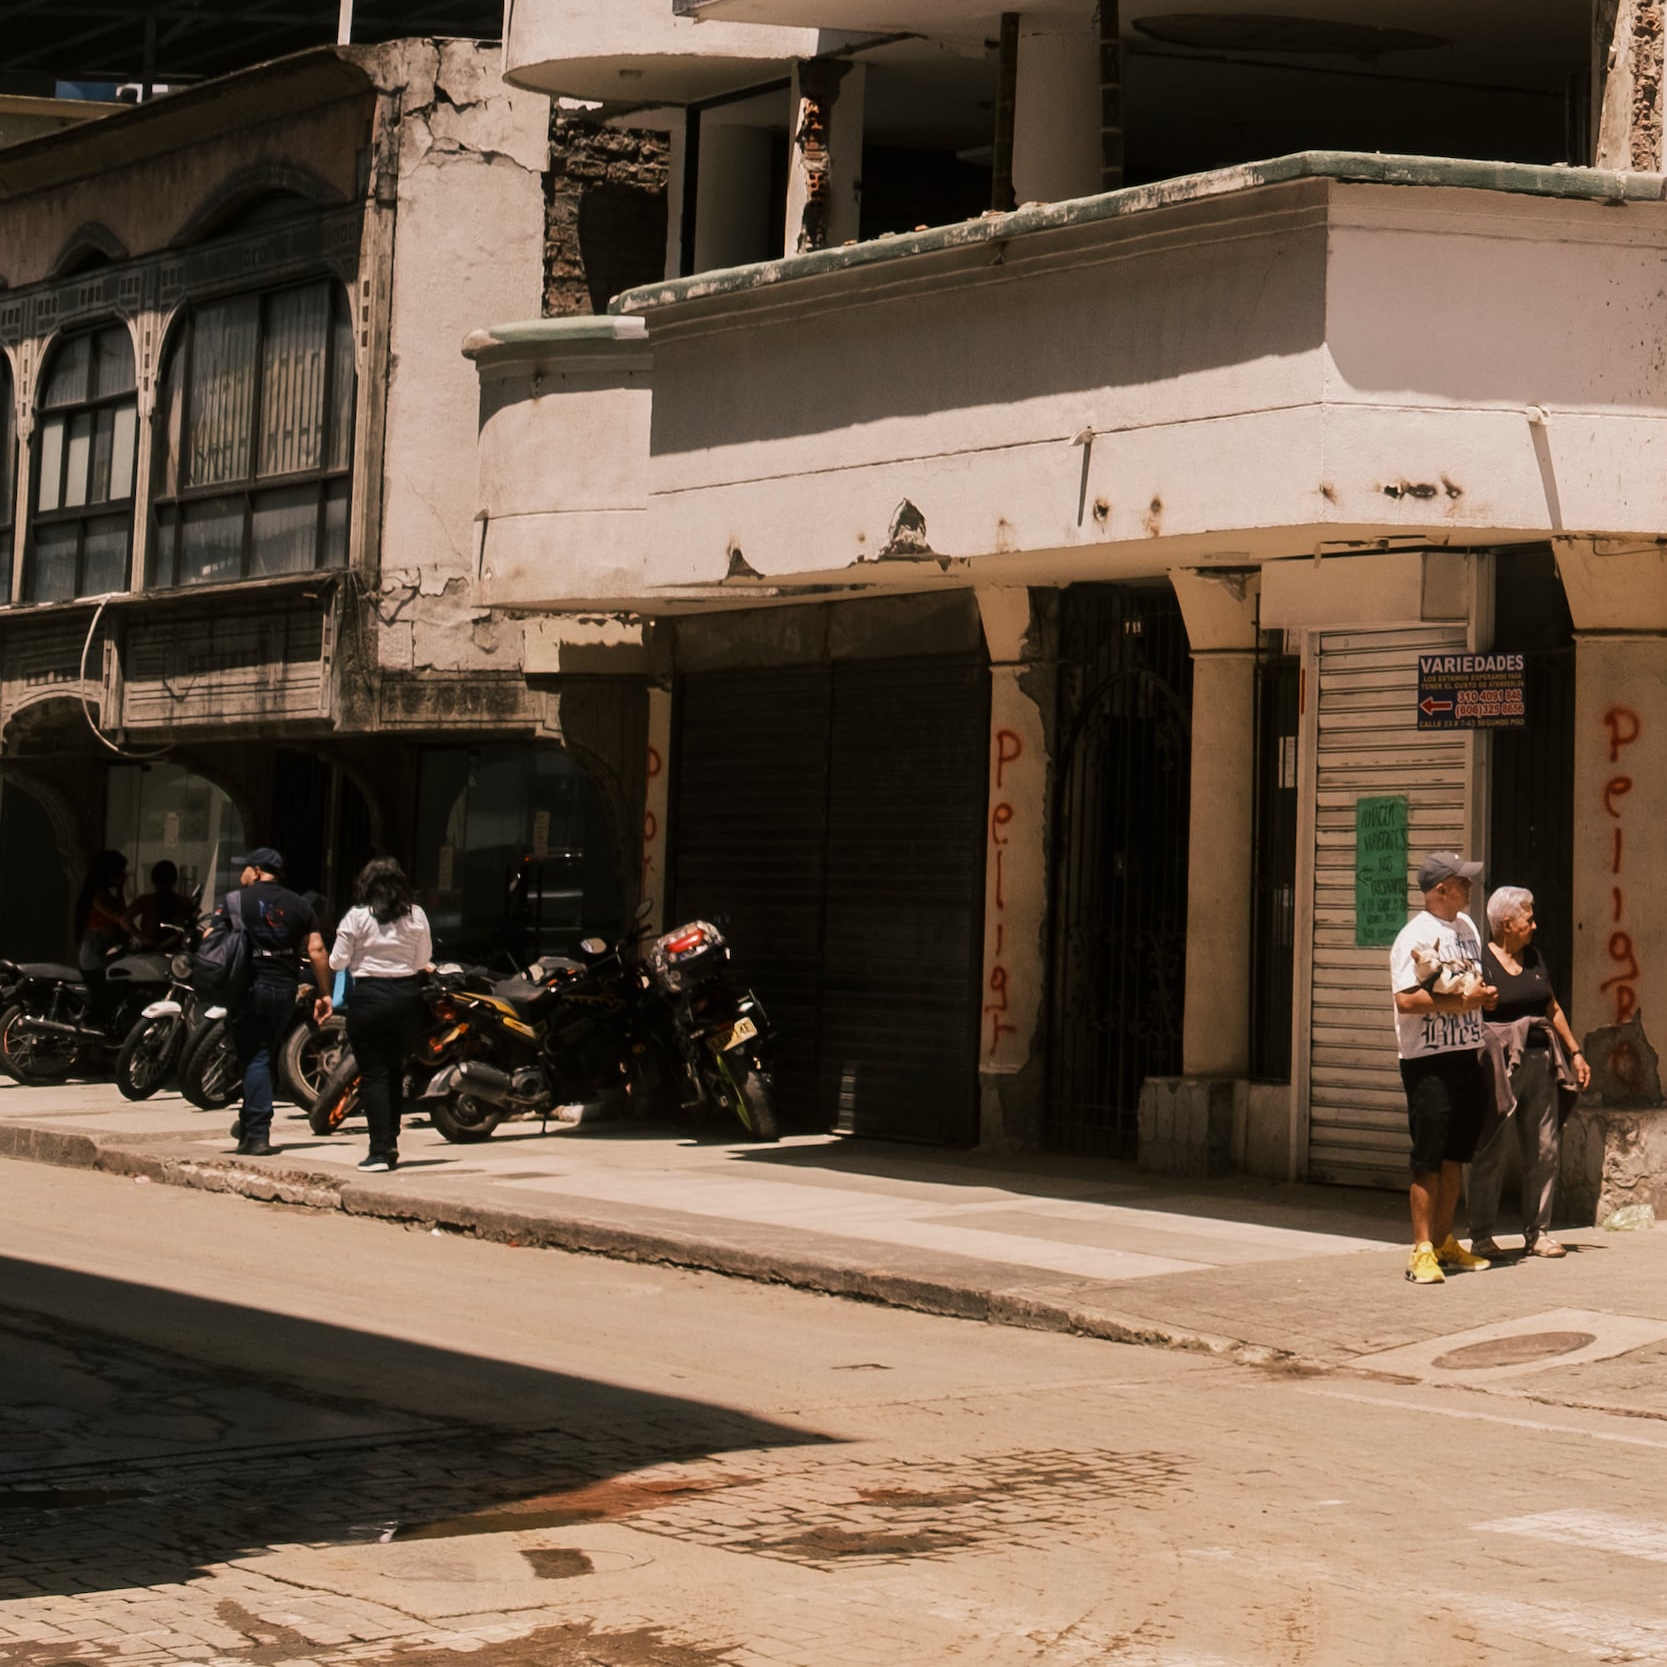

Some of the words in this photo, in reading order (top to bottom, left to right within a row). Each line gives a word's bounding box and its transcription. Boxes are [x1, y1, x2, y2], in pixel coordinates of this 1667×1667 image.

[1420, 655, 1524, 674] VARIEDADES
[1457, 690, 1479, 703] 310
[1479, 689, 1504, 702] 4091
